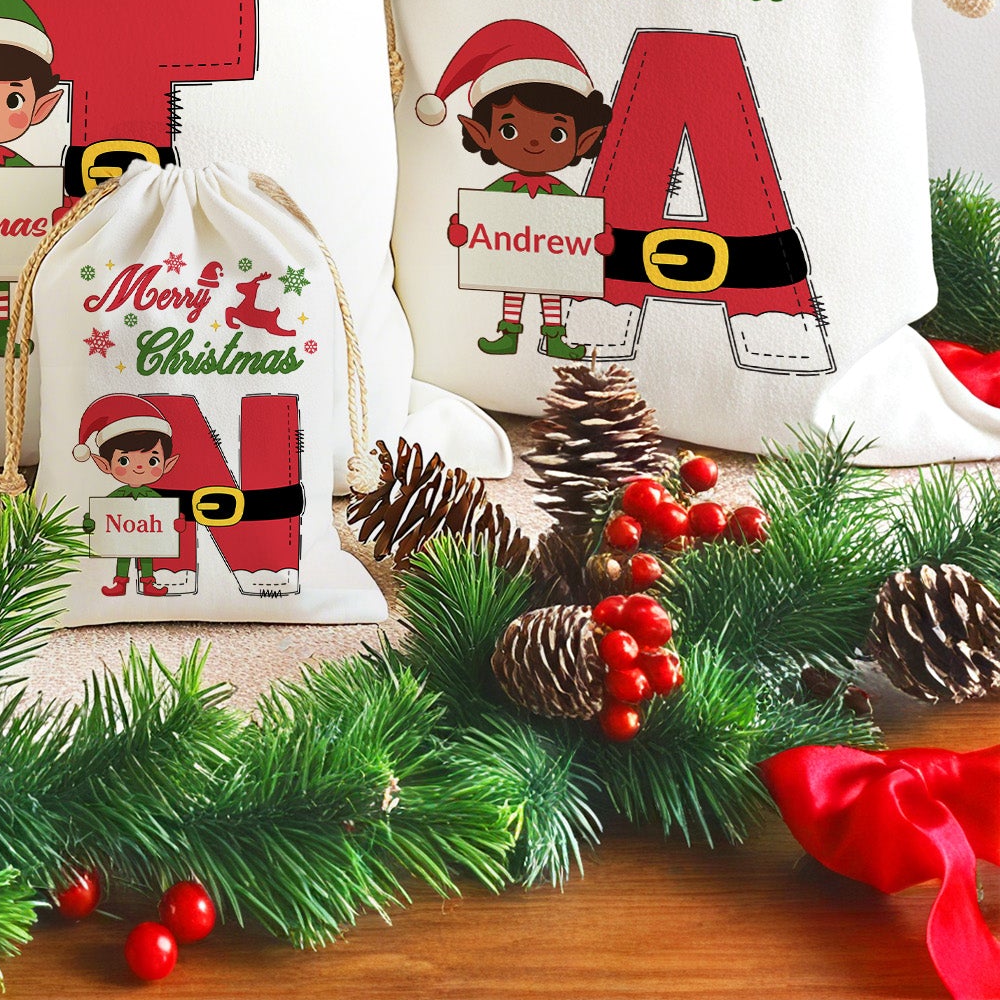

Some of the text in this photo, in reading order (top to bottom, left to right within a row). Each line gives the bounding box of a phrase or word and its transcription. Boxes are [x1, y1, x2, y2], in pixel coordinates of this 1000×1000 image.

[467, 223, 593, 257] Andrew
[83, 262, 213, 324] Merry
[135, 326, 306, 377] Christmas
[104, 513, 164, 535] Noah
